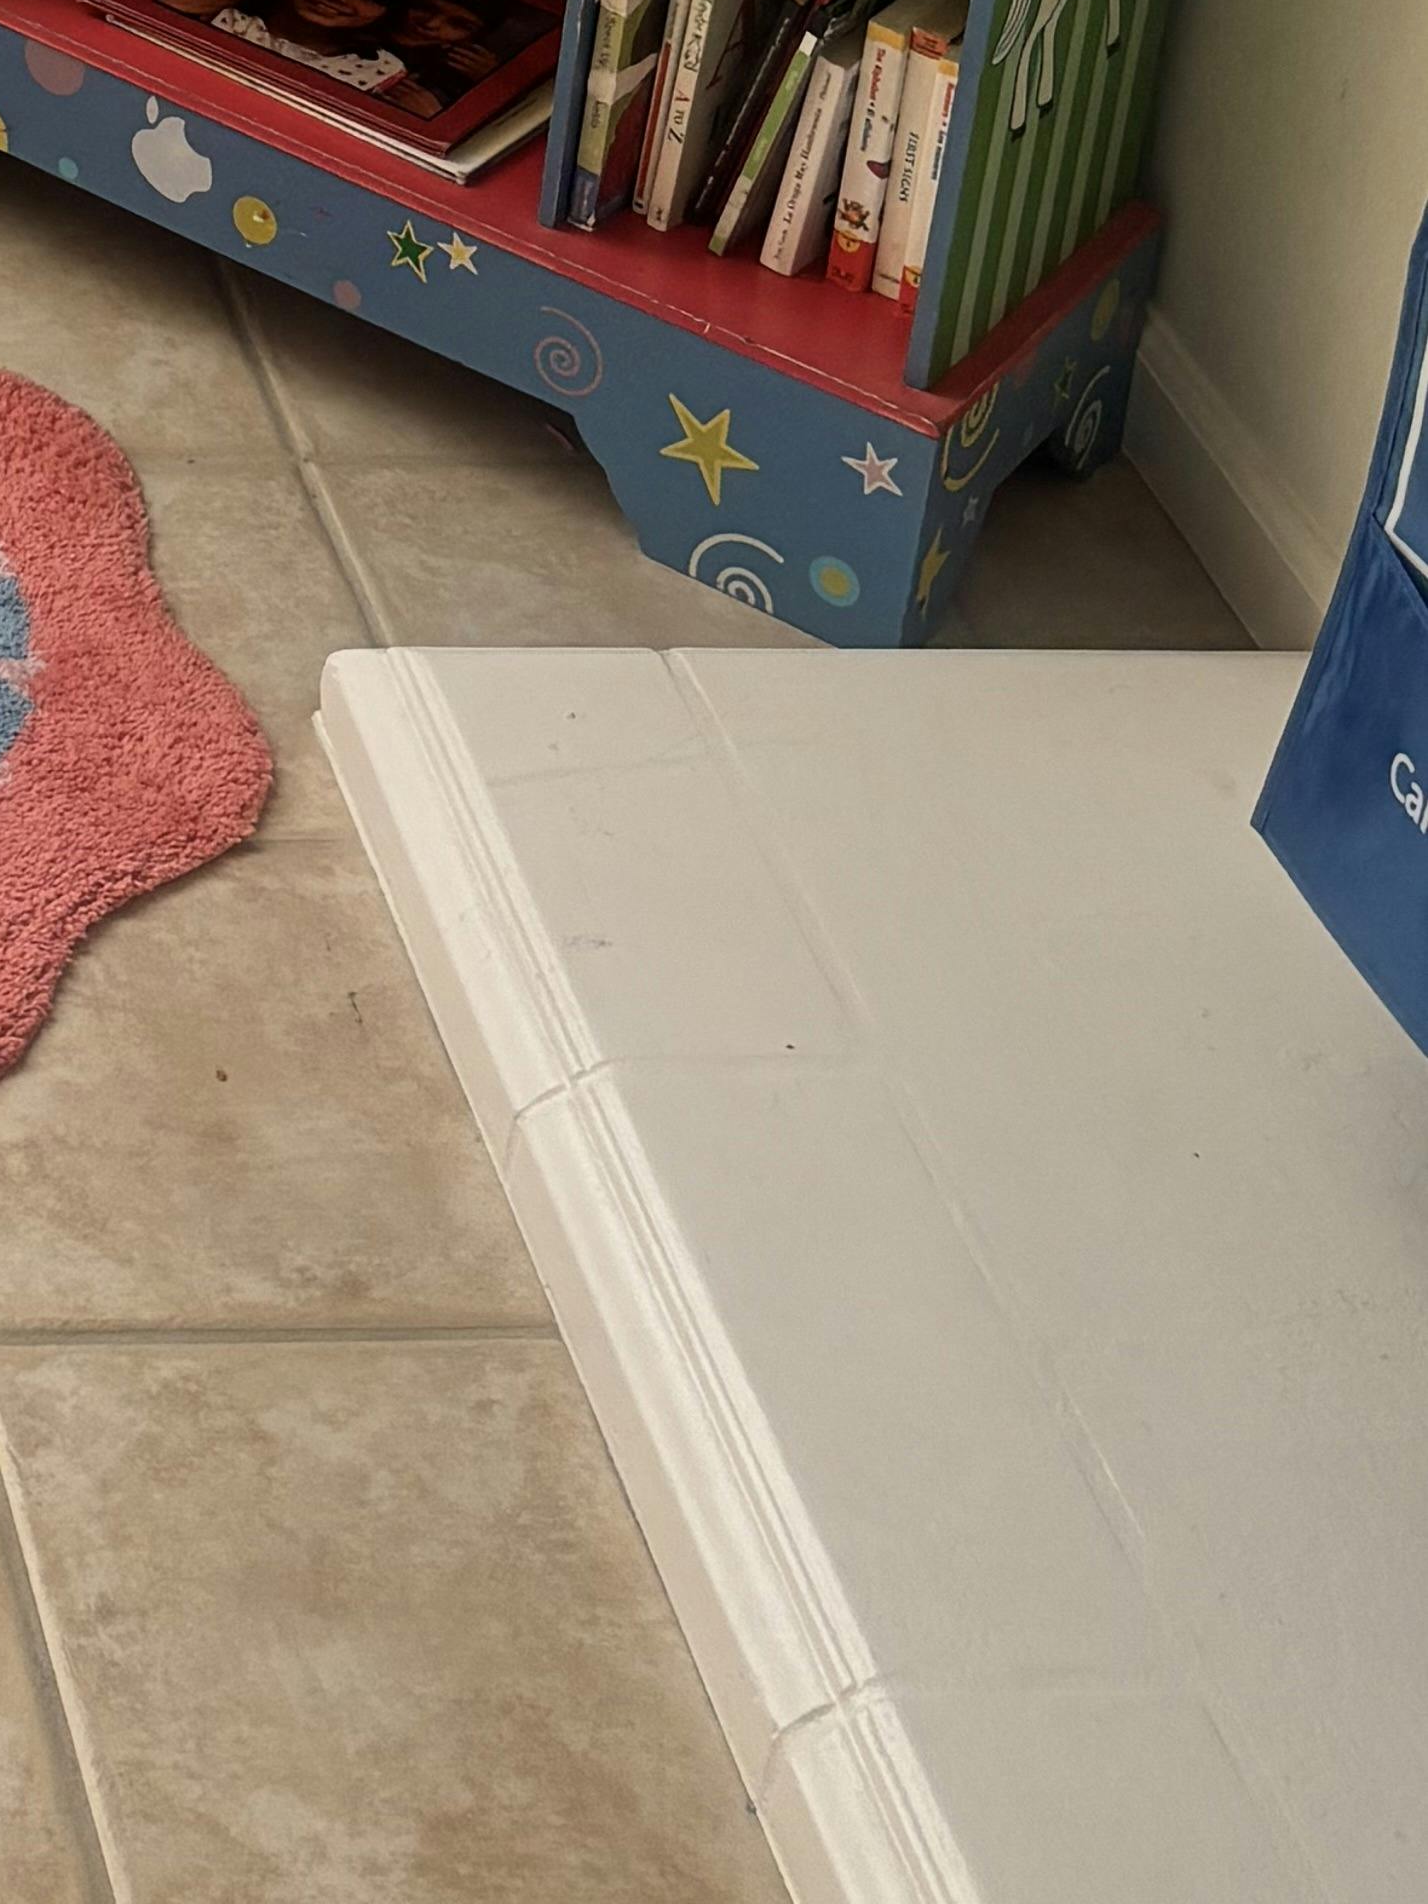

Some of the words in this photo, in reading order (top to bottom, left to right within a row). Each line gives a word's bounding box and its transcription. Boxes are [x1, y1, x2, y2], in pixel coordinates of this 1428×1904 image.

[870, 64, 883, 100] Alphabet
[675, 90, 691, 104] A
[666, 128, 684, 144] Z
[799, 106, 823, 159] Hambrienta
[904, 132, 919, 167] FIRST
[794, 160, 808, 180] Muy
[785, 182, 804, 210] Oruga
[898, 168, 912, 202] SIGNS
[782, 211, 793, 224] La
